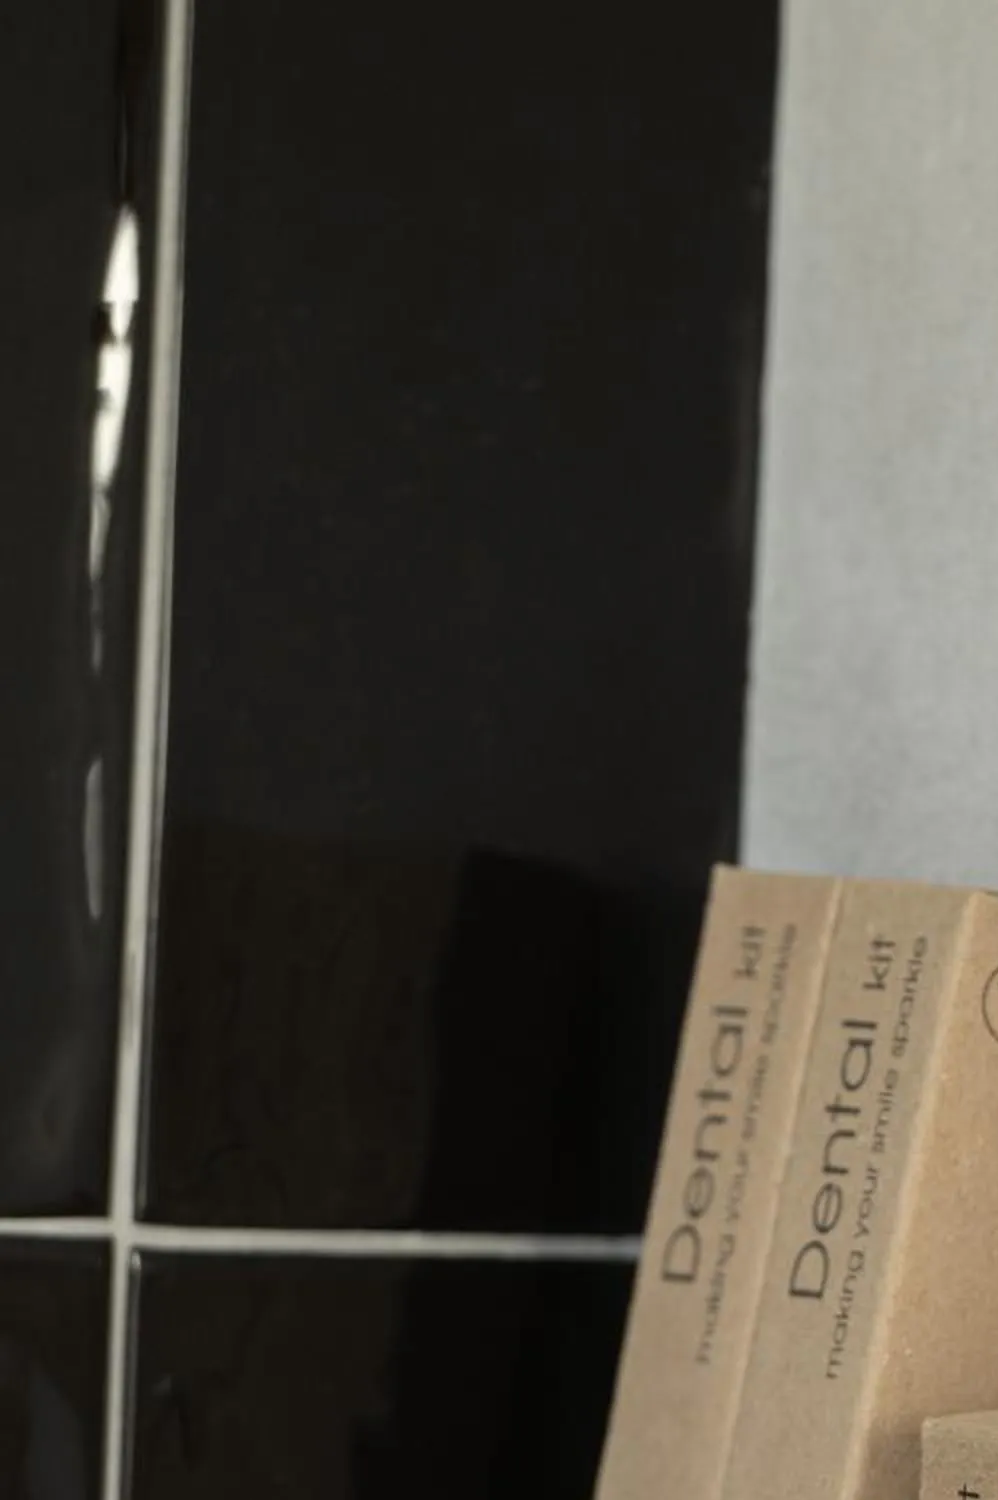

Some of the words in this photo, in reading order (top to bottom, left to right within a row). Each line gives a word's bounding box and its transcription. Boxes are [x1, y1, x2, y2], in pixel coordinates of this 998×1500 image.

[661, 1005, 748, 1283] Dental
[732, 925, 767, 981] kit
[788, 1018, 879, 1301] Dental
[862, 933, 897, 991] kit
[825, 1248, 867, 1380] making
[852, 1163, 881, 1239] your
[872, 1067, 900, 1152] smile
[891, 935, 929, 1058] sparkle
